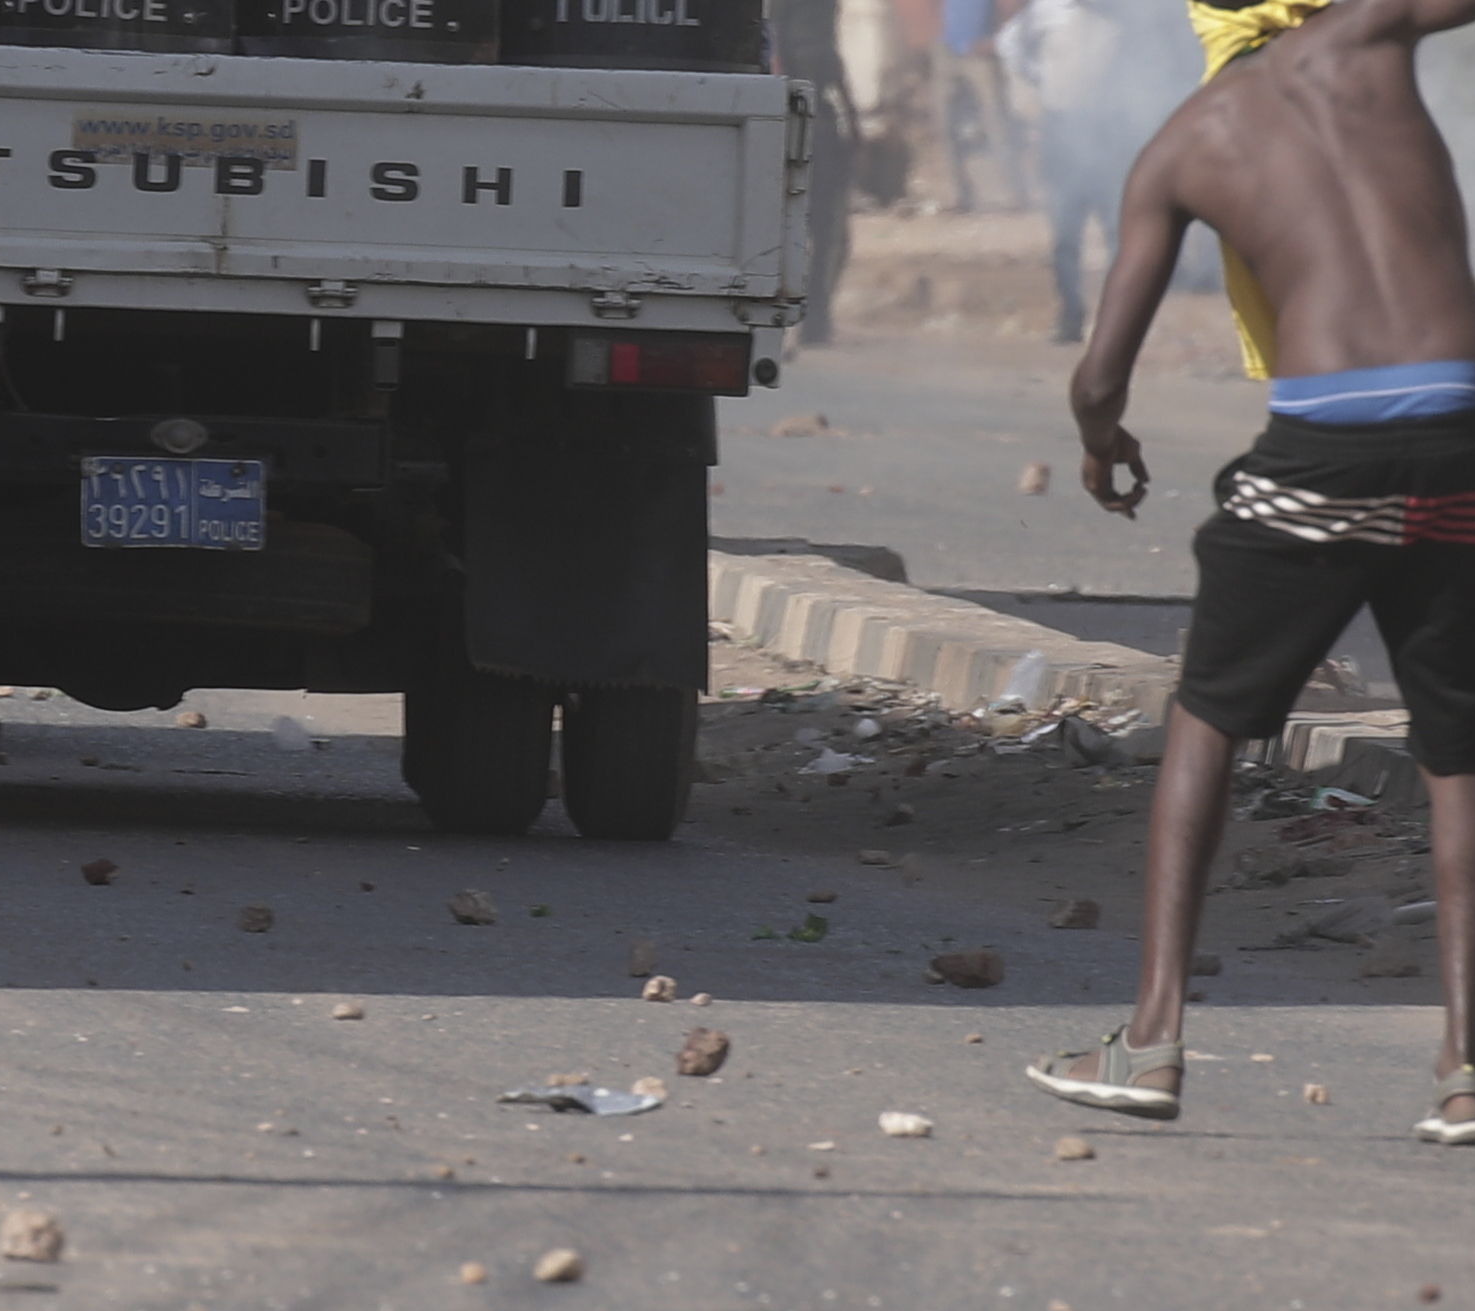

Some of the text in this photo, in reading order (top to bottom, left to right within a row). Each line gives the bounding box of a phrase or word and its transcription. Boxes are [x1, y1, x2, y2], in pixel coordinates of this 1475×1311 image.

[77, 116, 298, 142] www.ksp.gov.sd
[88, 504, 260, 542] 39291 POLICE
